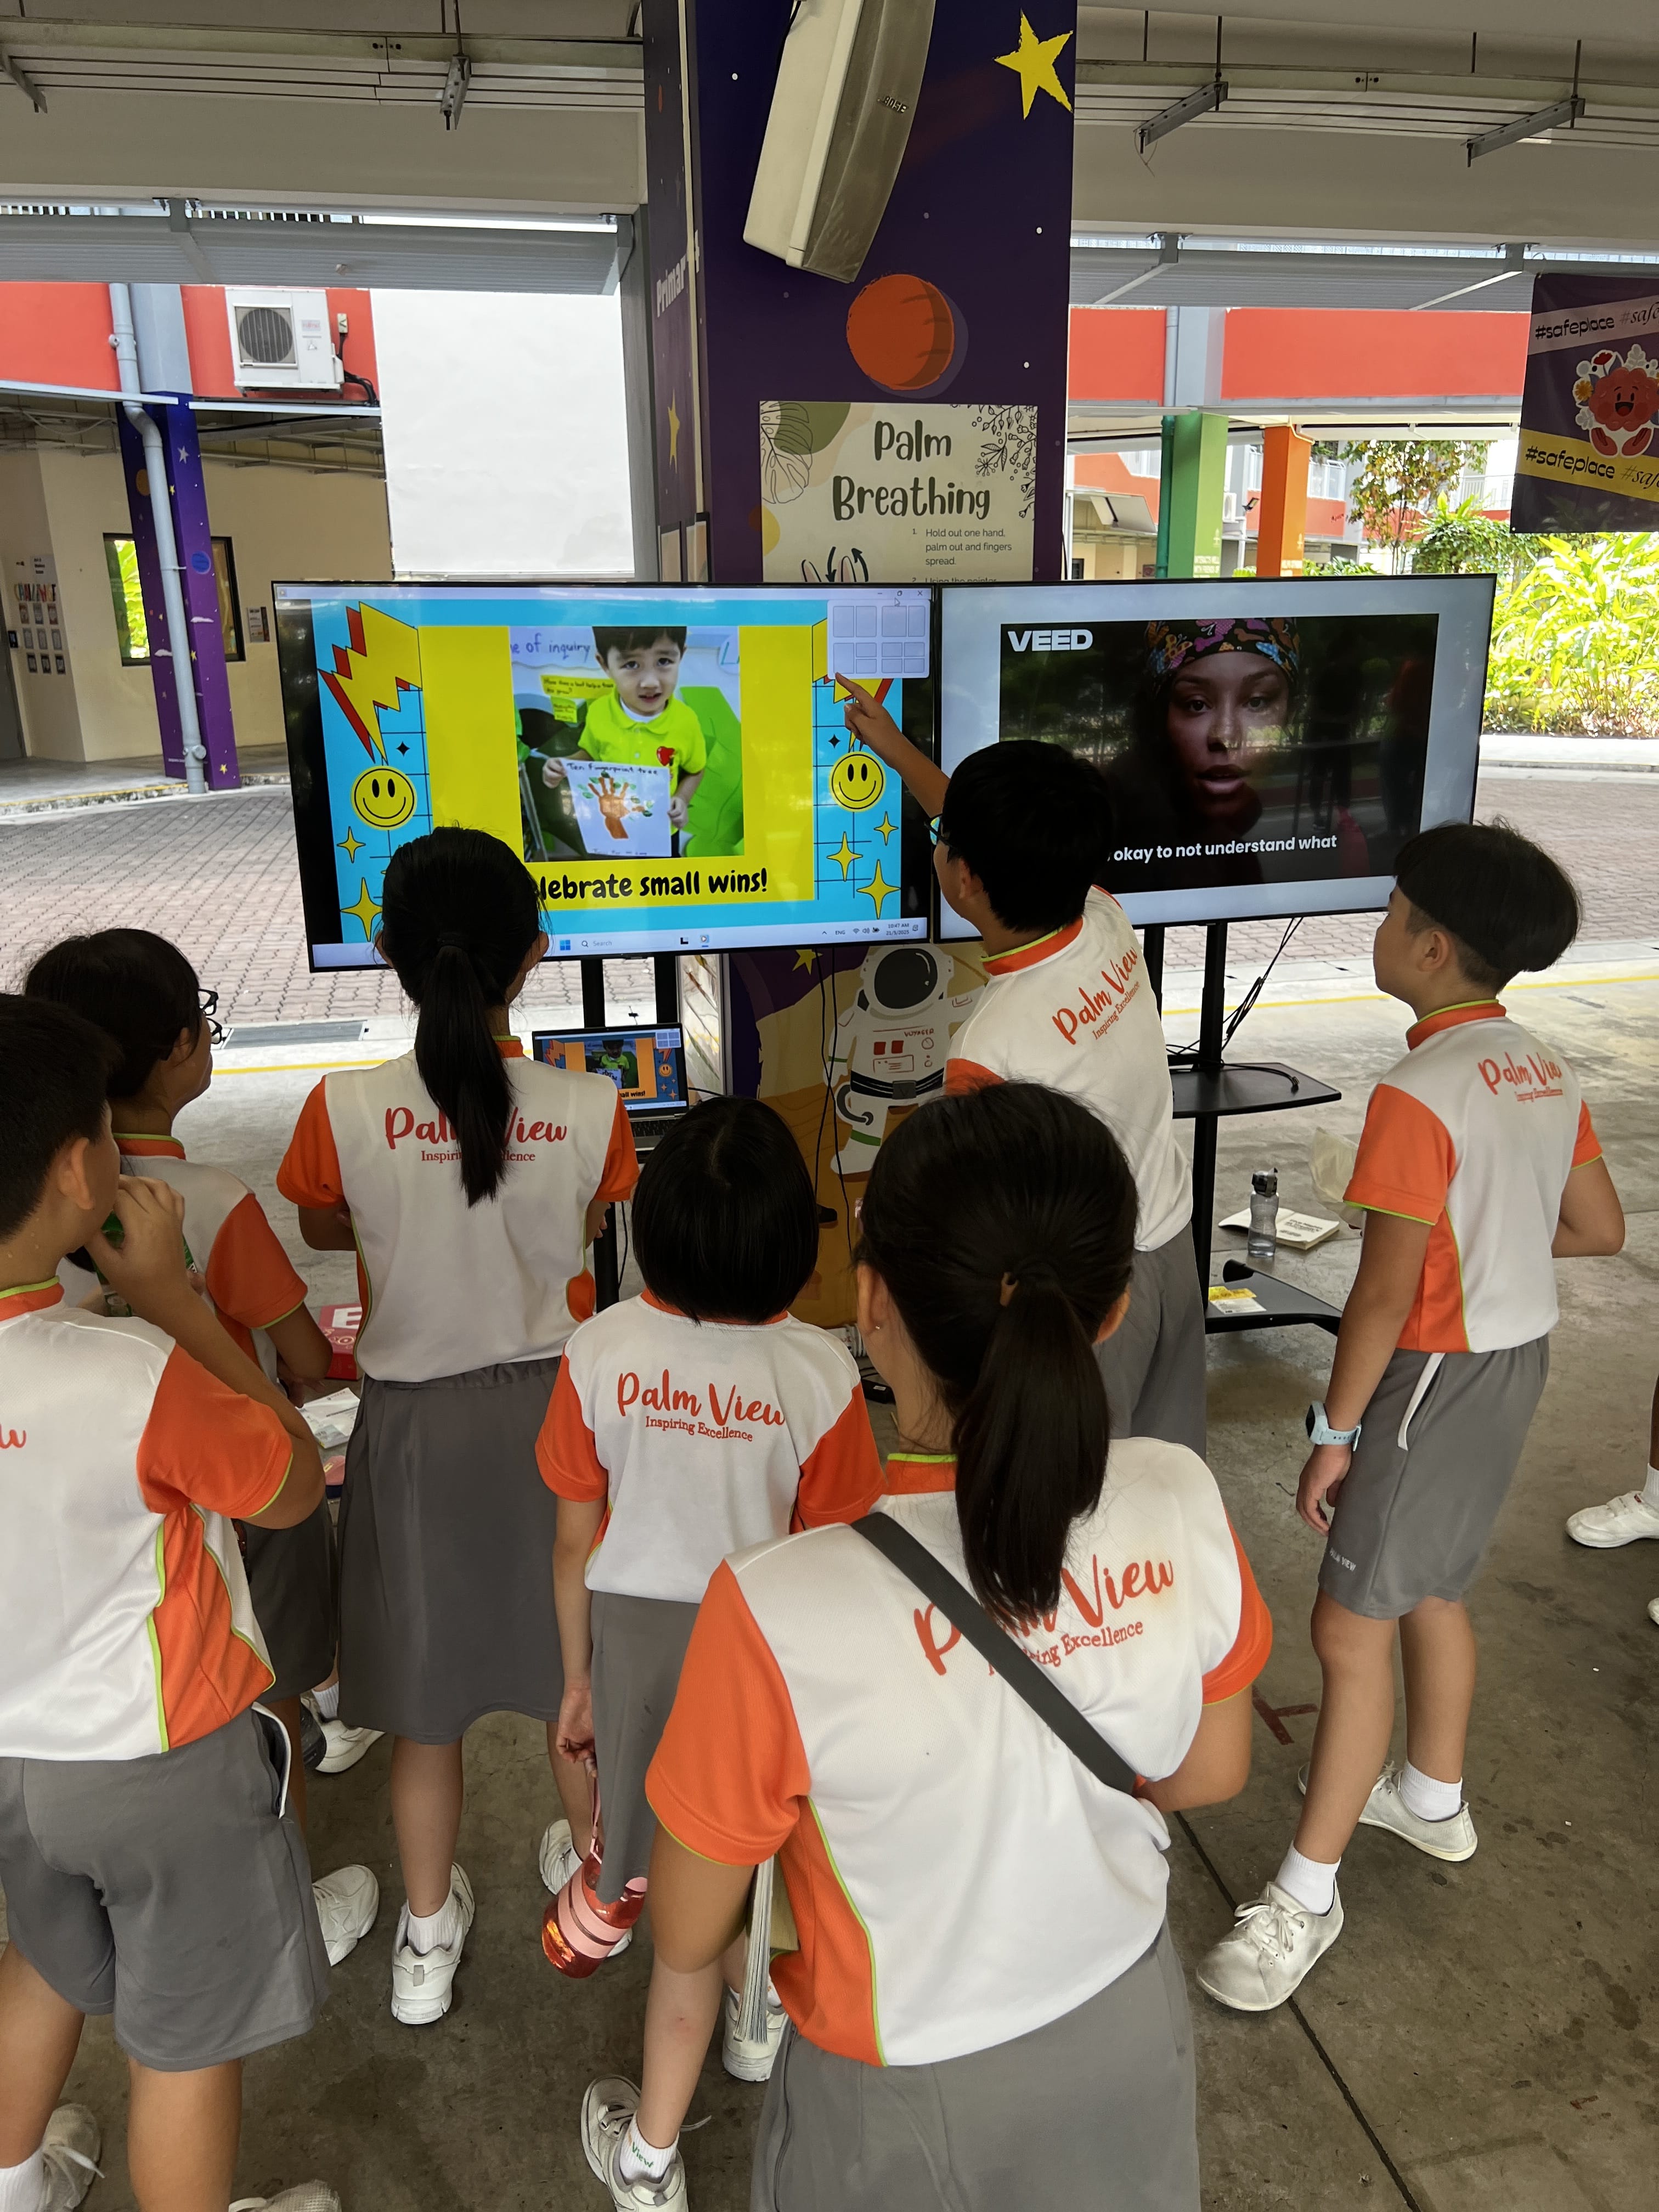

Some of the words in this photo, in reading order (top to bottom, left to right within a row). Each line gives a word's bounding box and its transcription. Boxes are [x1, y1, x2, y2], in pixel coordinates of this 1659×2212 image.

[878, 96, 907, 113] BOSE
[656, 253, 686, 318] Primar
[1535, 317, 1615, 340] #safeplace
[1620, 301, 1659, 326] #safe
[874, 419, 952, 462] Palm
[1525, 445, 1615, 479] #safeplace
[832, 475, 990, 521] Breathing
[926, 529, 946, 537] Hold
[948, 529, 962, 537] out
[926, 543, 947, 553] palm
[949, 543, 963, 551] out
[984, 543, 1012, 553] fingers
[925, 557, 957, 567] spread.
[526, 633, 542, 653] of
[549, 640, 590, 663] inquiry
[1008, 629, 1093, 652] VEED
[1114, 847, 1153, 864] okay
[1156, 845, 1172, 859] to
[1176, 843, 1201, 857] not
[1205, 837, 1295, 855] understand
[1298, 835, 1338, 850] what
[539, 873, 633, 900] lebrate
[639, 871, 699, 896] small
[708, 867, 767, 894] wins!
[1052, 987, 1112, 1045] Palm
[1101, 946, 1137, 995] View
[1092, 1011, 1120, 1040] Inspiring
[1114, 981, 1140, 1015] Excellence
[1477, 1051, 1532, 1096] Palm
[421, 1150, 462, 1164] Inspiri
[501, 1150, 536, 1161] llence
[617, 1369, 702, 1417] Palm
[645, 1416, 695, 1436] Inspiring
[697, 1421, 753, 1442] Excellence
[913, 1602, 1058, 1676] Pm
[1060, 1554, 1174, 1628] View
[1061, 1621, 1144, 1656] Excellence
[632, 2142, 654, 2168] View
